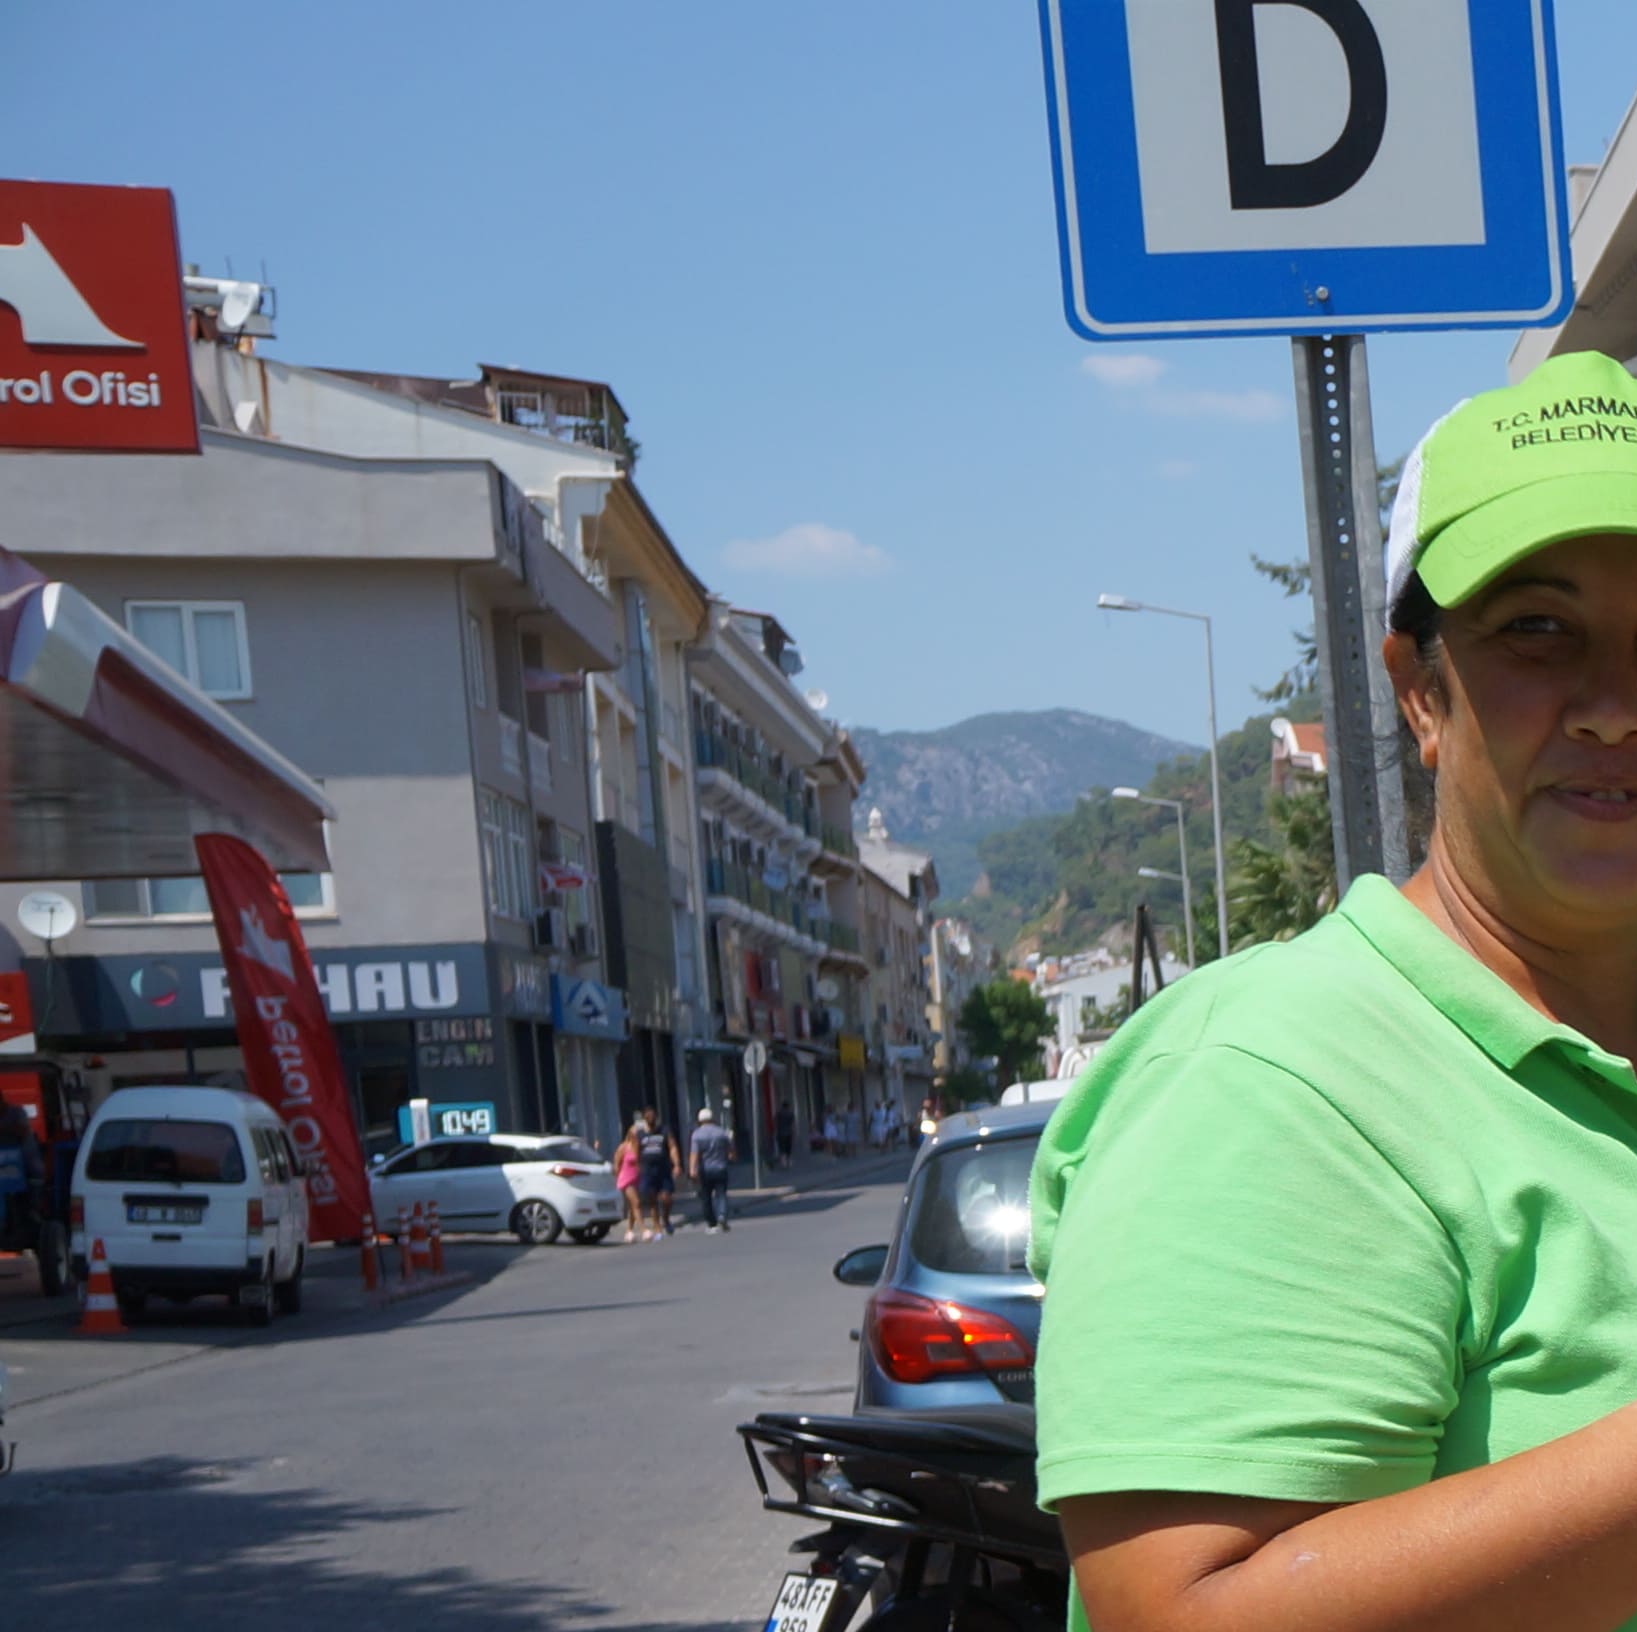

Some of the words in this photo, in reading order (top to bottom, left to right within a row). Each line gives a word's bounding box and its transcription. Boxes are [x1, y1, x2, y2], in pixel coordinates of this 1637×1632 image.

[1214, 0, 1388, 211] D
[62, 370, 161, 407] Ofisi
[1493, 412, 1532, 433] T.C.
